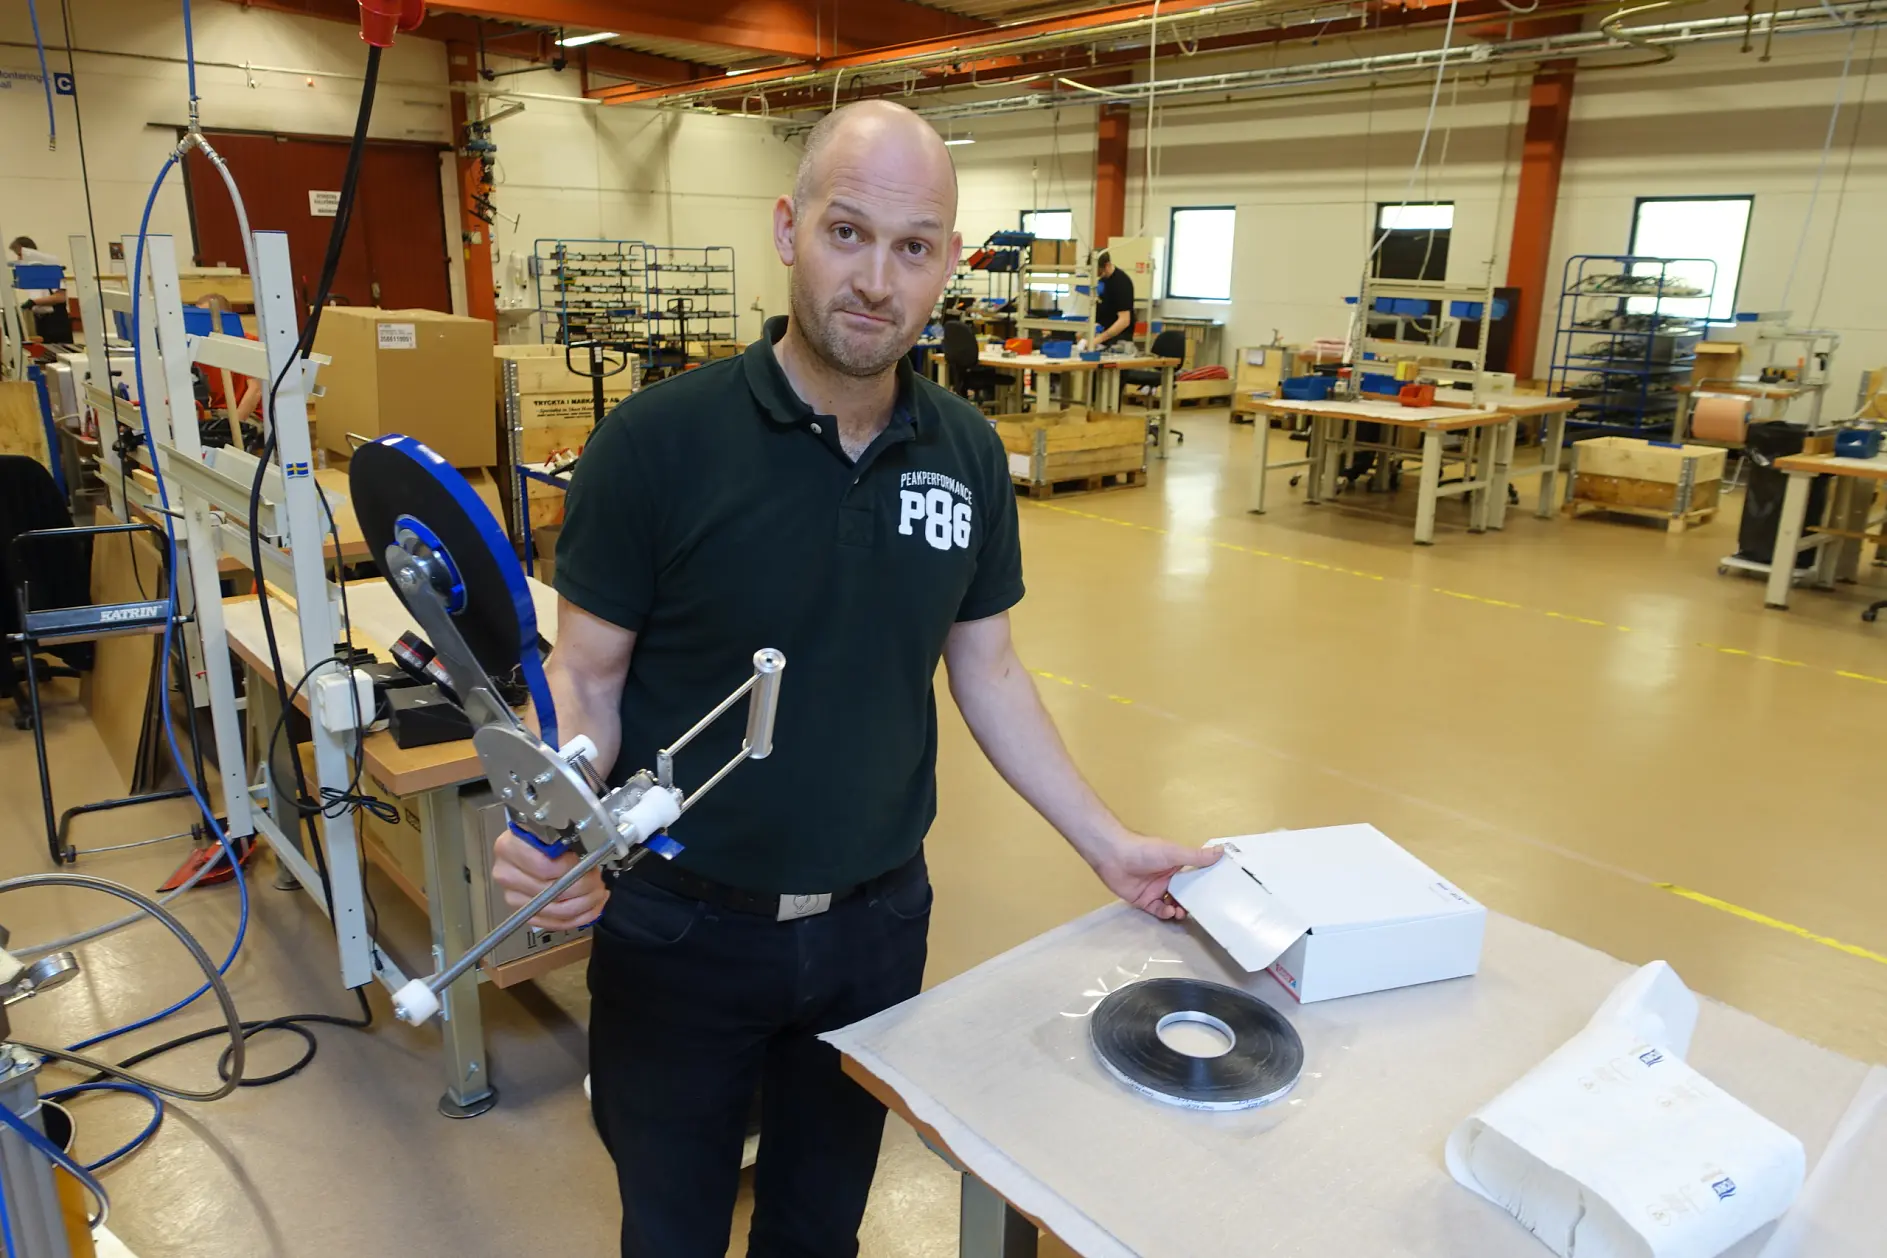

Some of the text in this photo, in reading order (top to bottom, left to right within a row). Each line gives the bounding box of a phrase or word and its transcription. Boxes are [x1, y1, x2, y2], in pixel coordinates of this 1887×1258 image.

[57, 77, 72, 91] C
[898, 488, 972, 550] P86
[100, 606, 158, 622] KATRIN
